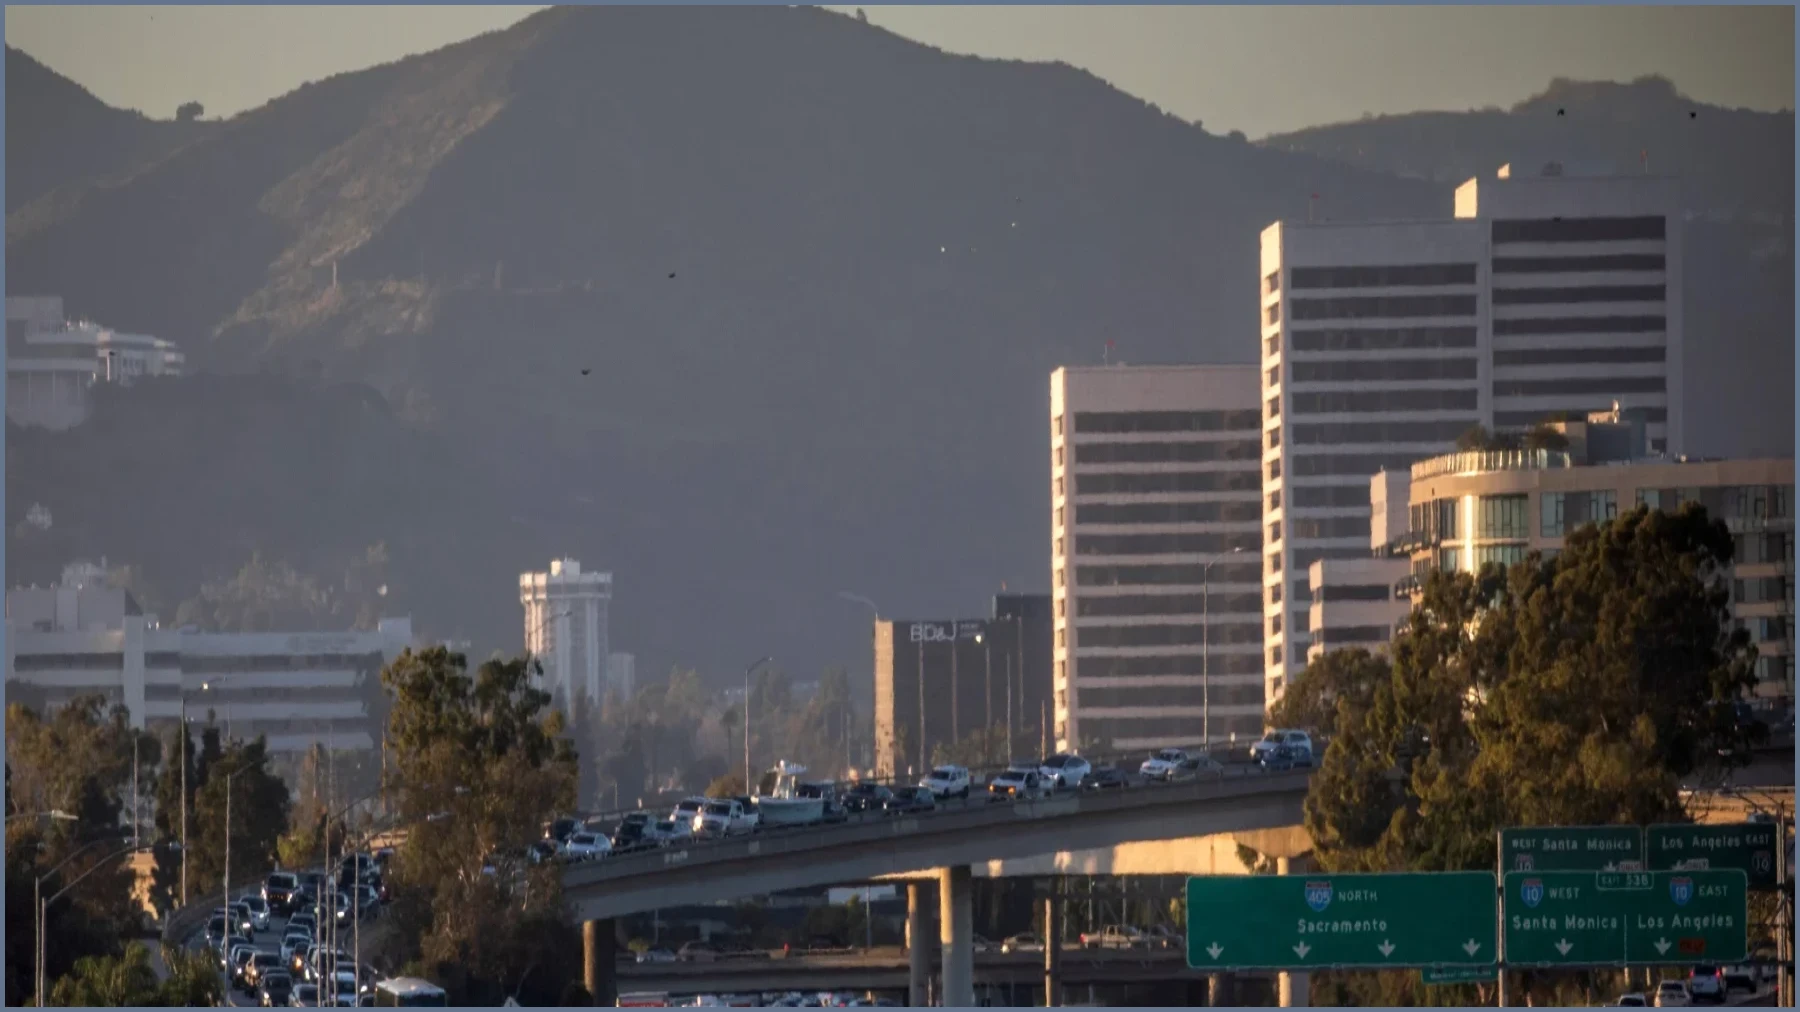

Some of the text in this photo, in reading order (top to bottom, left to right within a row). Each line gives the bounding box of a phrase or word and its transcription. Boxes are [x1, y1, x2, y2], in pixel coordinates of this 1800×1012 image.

[910, 623, 957, 642] BD&J
[1512, 837, 1632, 851] WEST Santa Monica
[1661, 834, 1740, 852] Los Angeles
[1745, 833, 1769, 845] EAST
[1309, 890, 1330, 903] 405
[1338, 889, 1378, 902] NORTH
[1527, 886, 1539, 901] 10
[1548, 886, 1580, 900] WEST
[1675, 886, 1687, 901] 10
[1698, 885, 1728, 897] EAST
[1297, 917, 1388, 934] Sacramento
[1512, 914, 1618, 931] Santa Monica
[1637, 912, 1733, 932] Los Angeles
